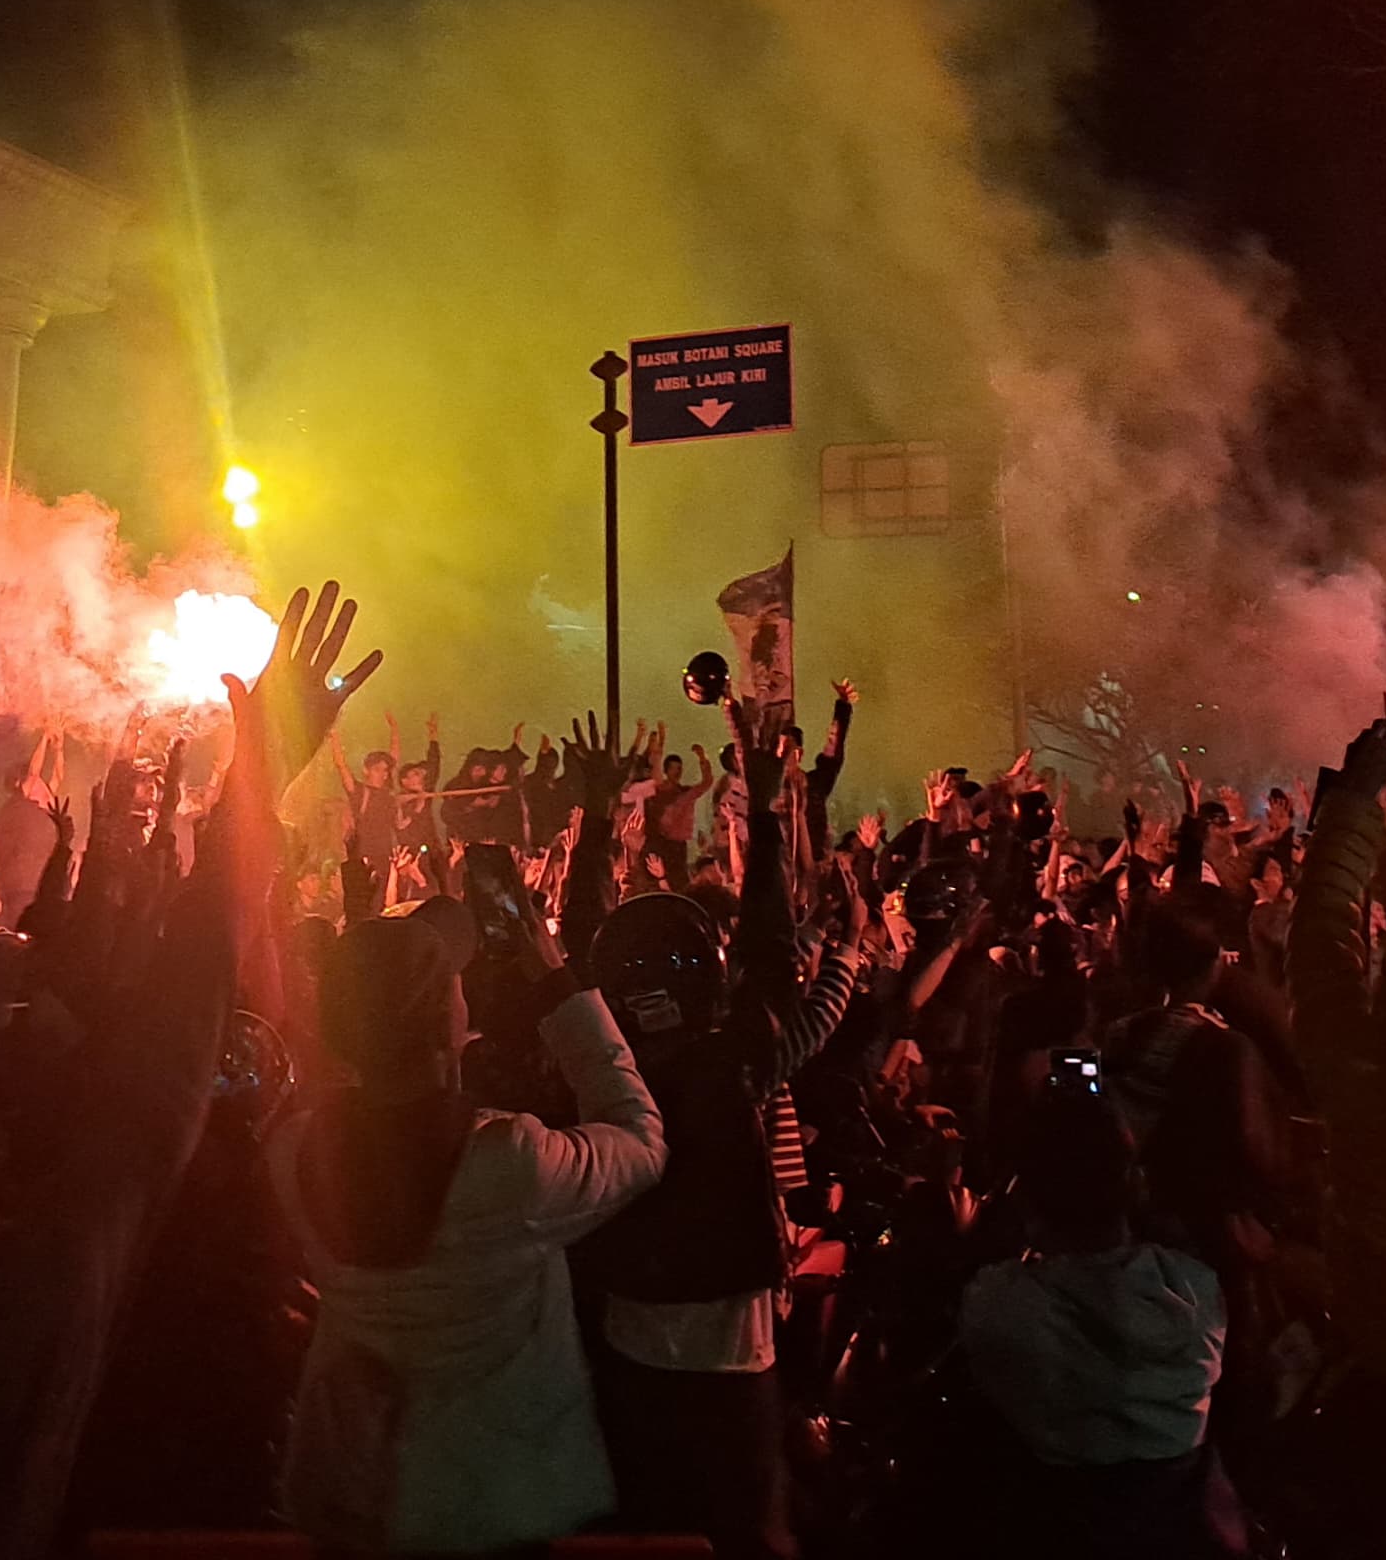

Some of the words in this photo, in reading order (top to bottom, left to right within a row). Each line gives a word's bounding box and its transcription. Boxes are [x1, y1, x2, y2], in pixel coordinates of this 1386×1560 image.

[637, 351, 678, 367] MASUK
[684, 346, 729, 363] BOTANI
[734, 340, 783, 357] SQUARE
[655, 376, 691, 392] AMBIL
[696, 371, 736, 387] LAJUR
[741, 368, 767, 383] KIRI
